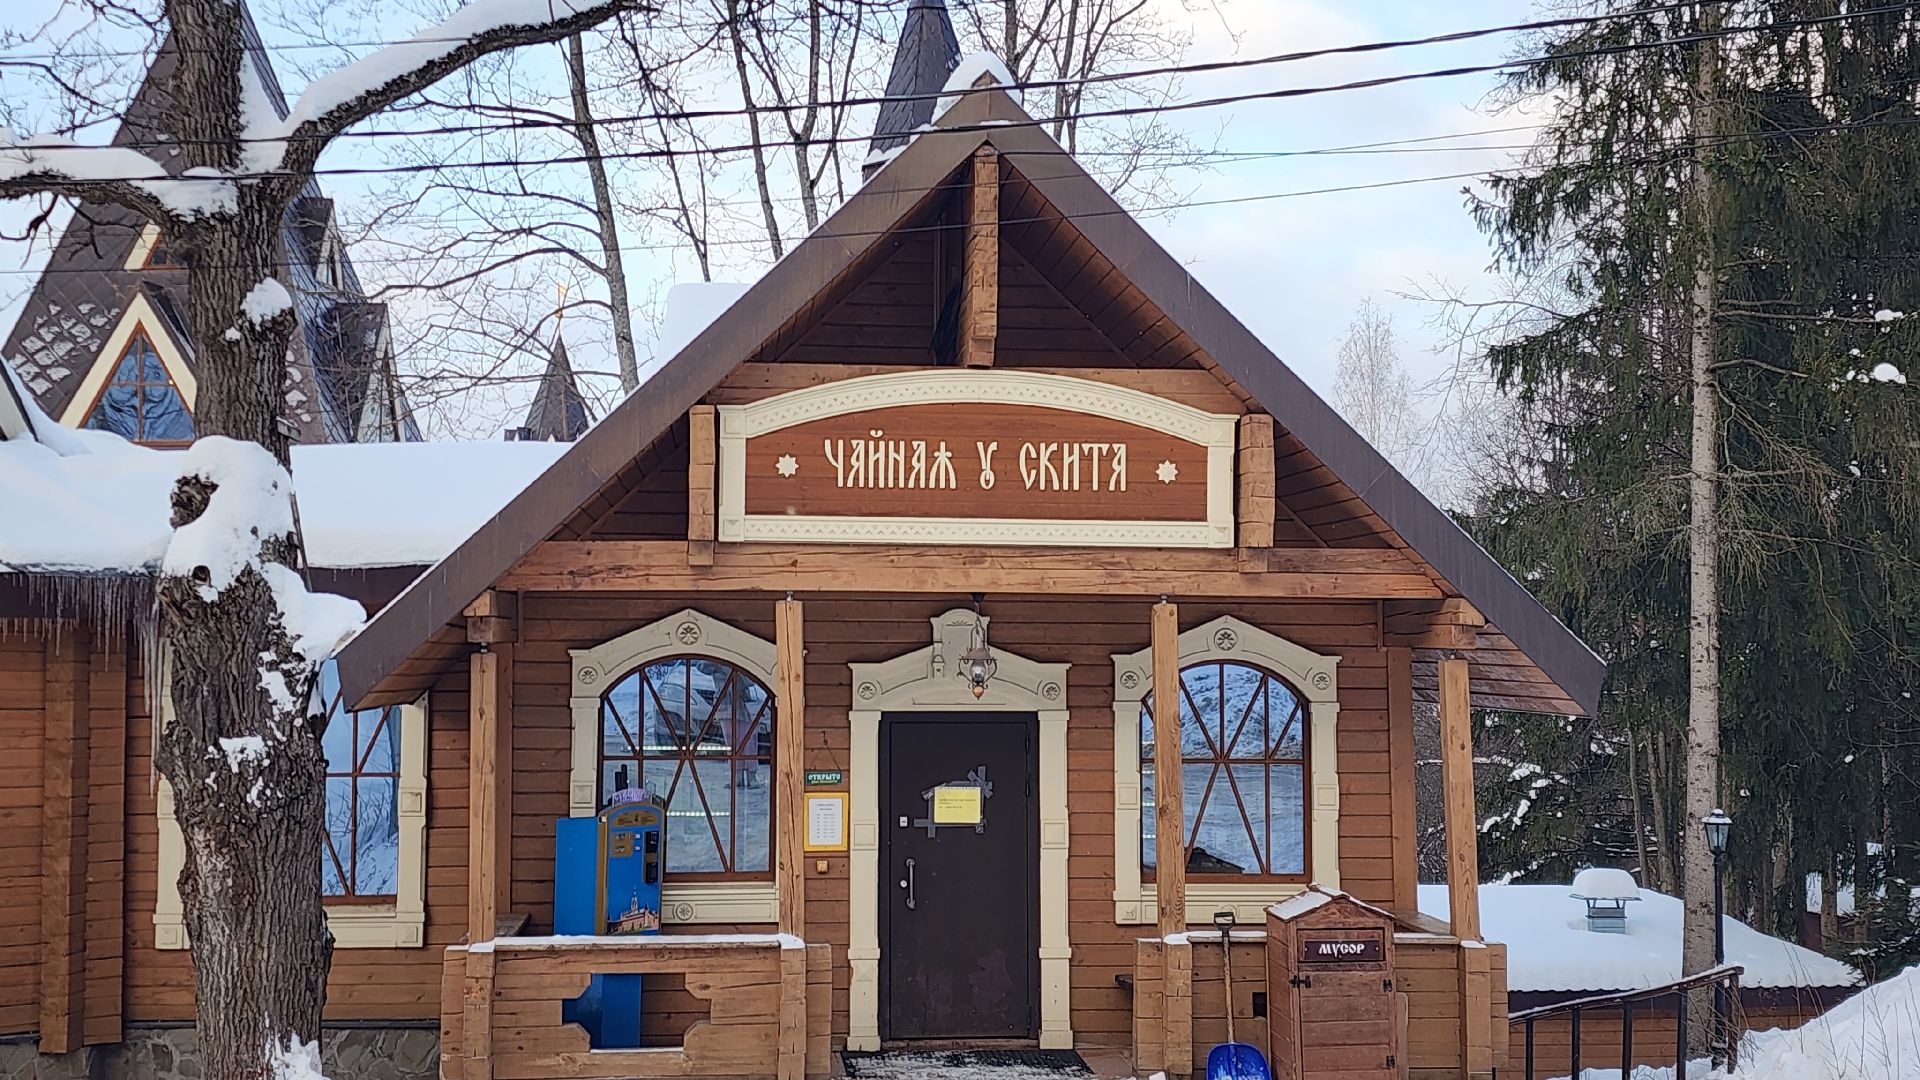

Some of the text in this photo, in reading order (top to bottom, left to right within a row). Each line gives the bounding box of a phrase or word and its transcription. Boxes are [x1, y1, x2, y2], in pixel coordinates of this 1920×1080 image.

[1019, 442, 1127, 491] СКИТА
[808, 773, 841, 781] ОТКРЫТО
[1318, 943, 1365, 957] МУСОР
